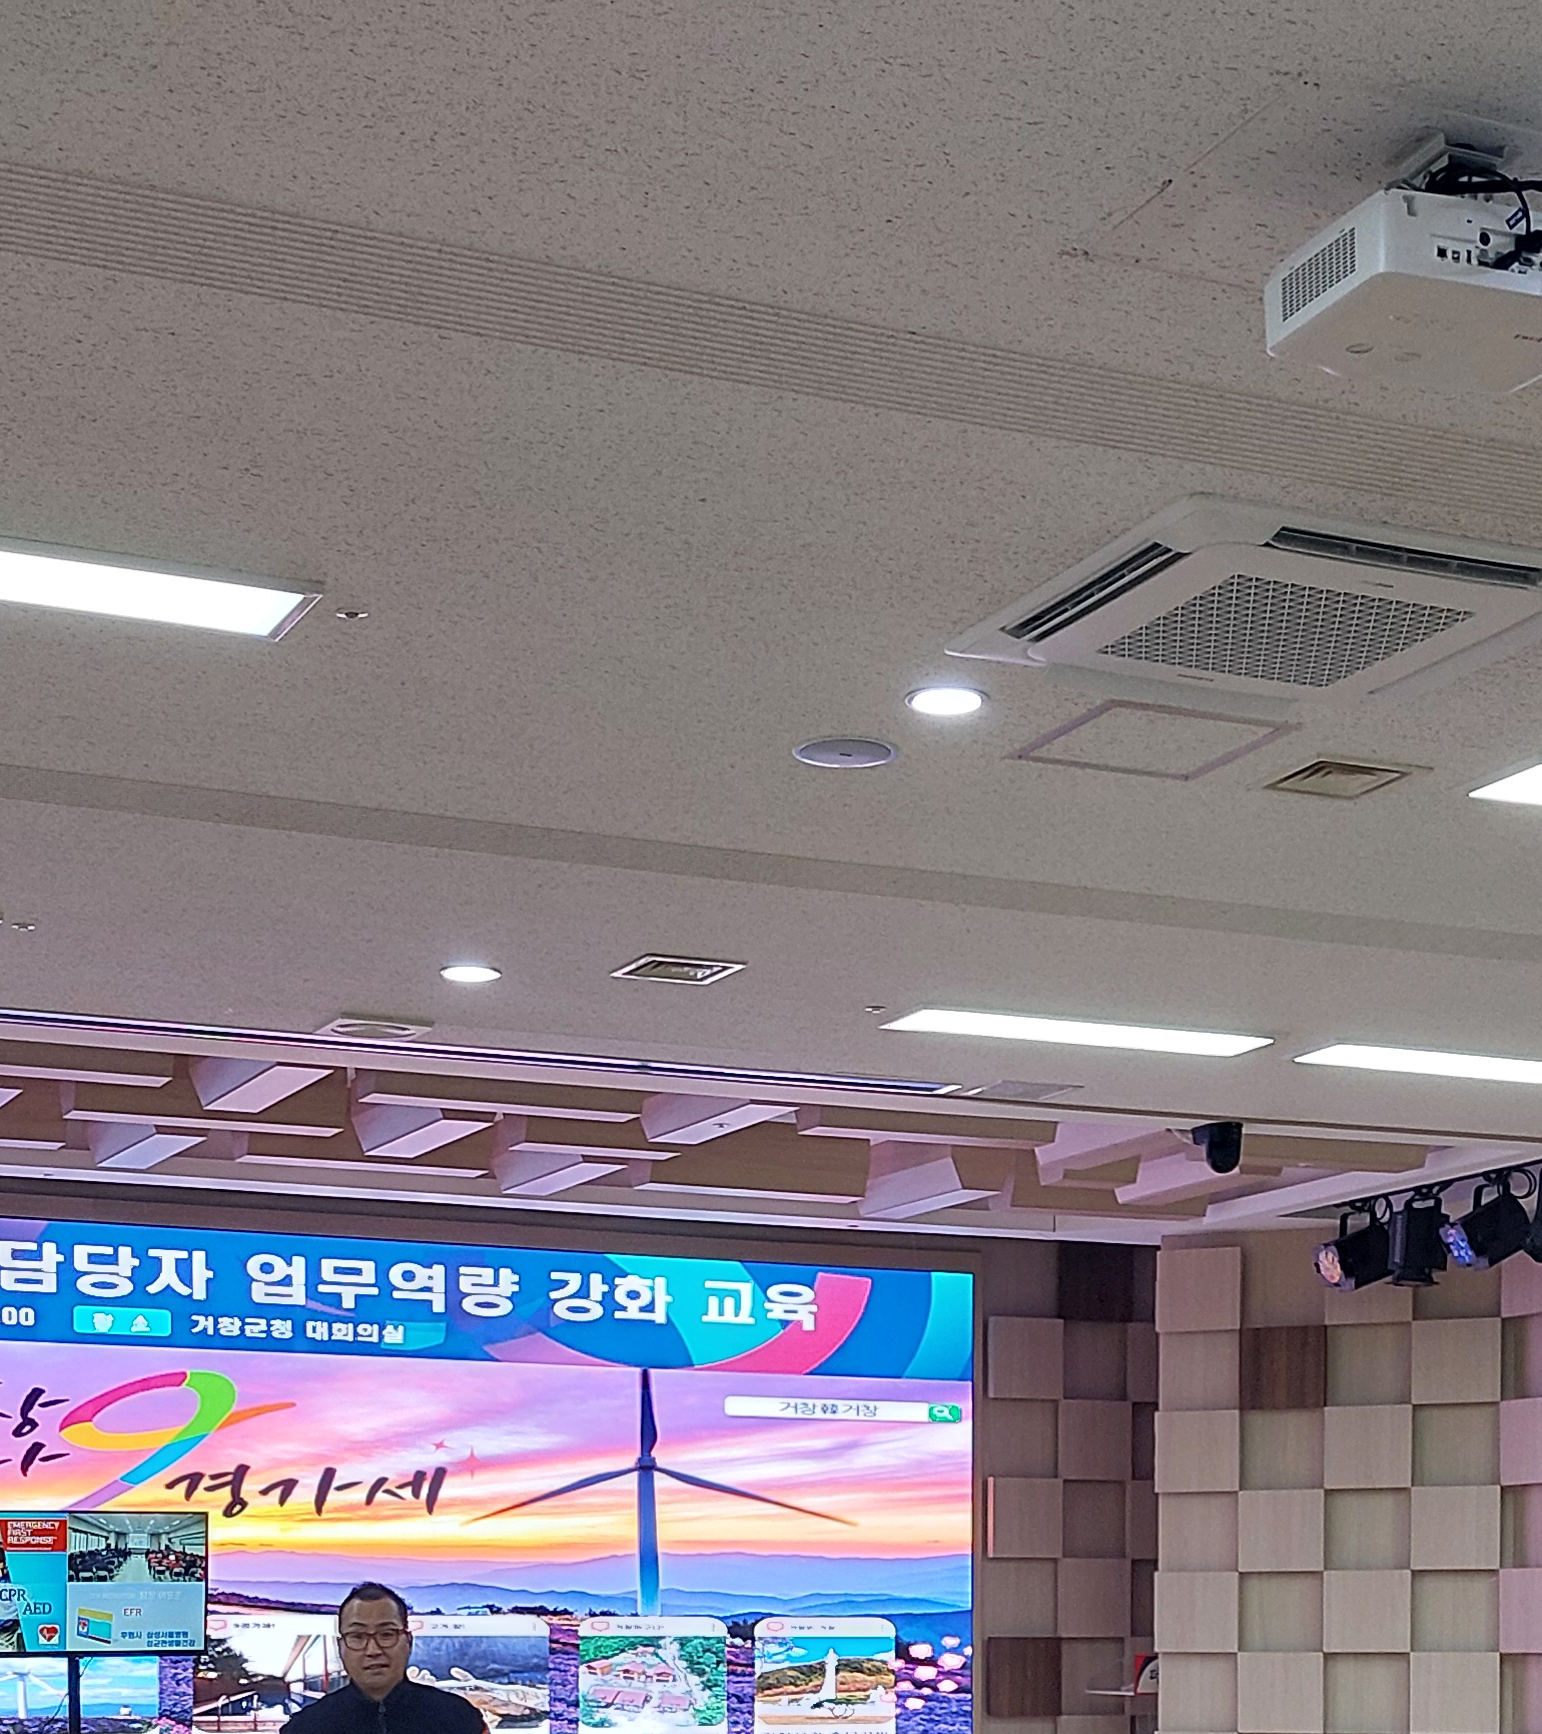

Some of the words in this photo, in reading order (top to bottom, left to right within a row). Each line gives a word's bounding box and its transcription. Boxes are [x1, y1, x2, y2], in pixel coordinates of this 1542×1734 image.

[245, 1252, 521, 1318] 업무역량
[549, 1270, 673, 1325] 강화
[701, 1279, 820, 1331] 교육
[190, 1314, 294, 1339] 거창군청
[305, 1320, 406, 1345] 대회의실
[22, 1602, 52, 1615] AED
[123, 1608, 142, 1617] EFR
